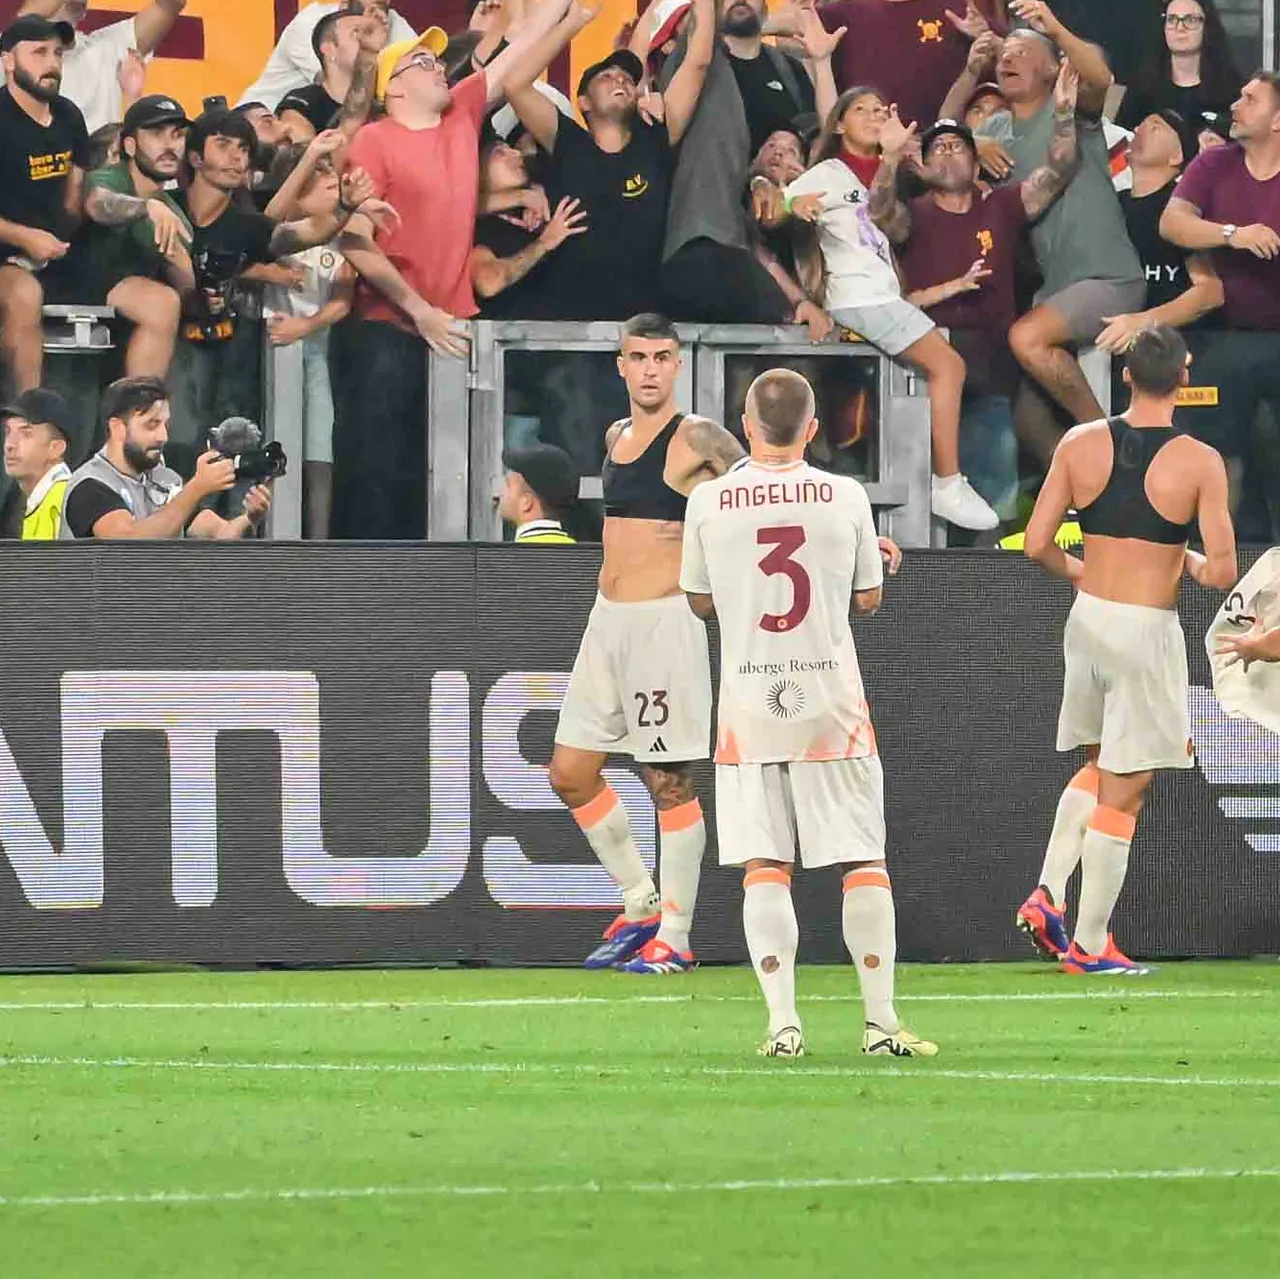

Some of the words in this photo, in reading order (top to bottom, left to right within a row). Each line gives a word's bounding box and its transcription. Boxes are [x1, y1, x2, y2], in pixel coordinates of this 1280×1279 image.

[720, 479, 834, 511] ANGELIÑO
[756, 525, 812, 634] 3
[634, 690, 670, 727] 23
